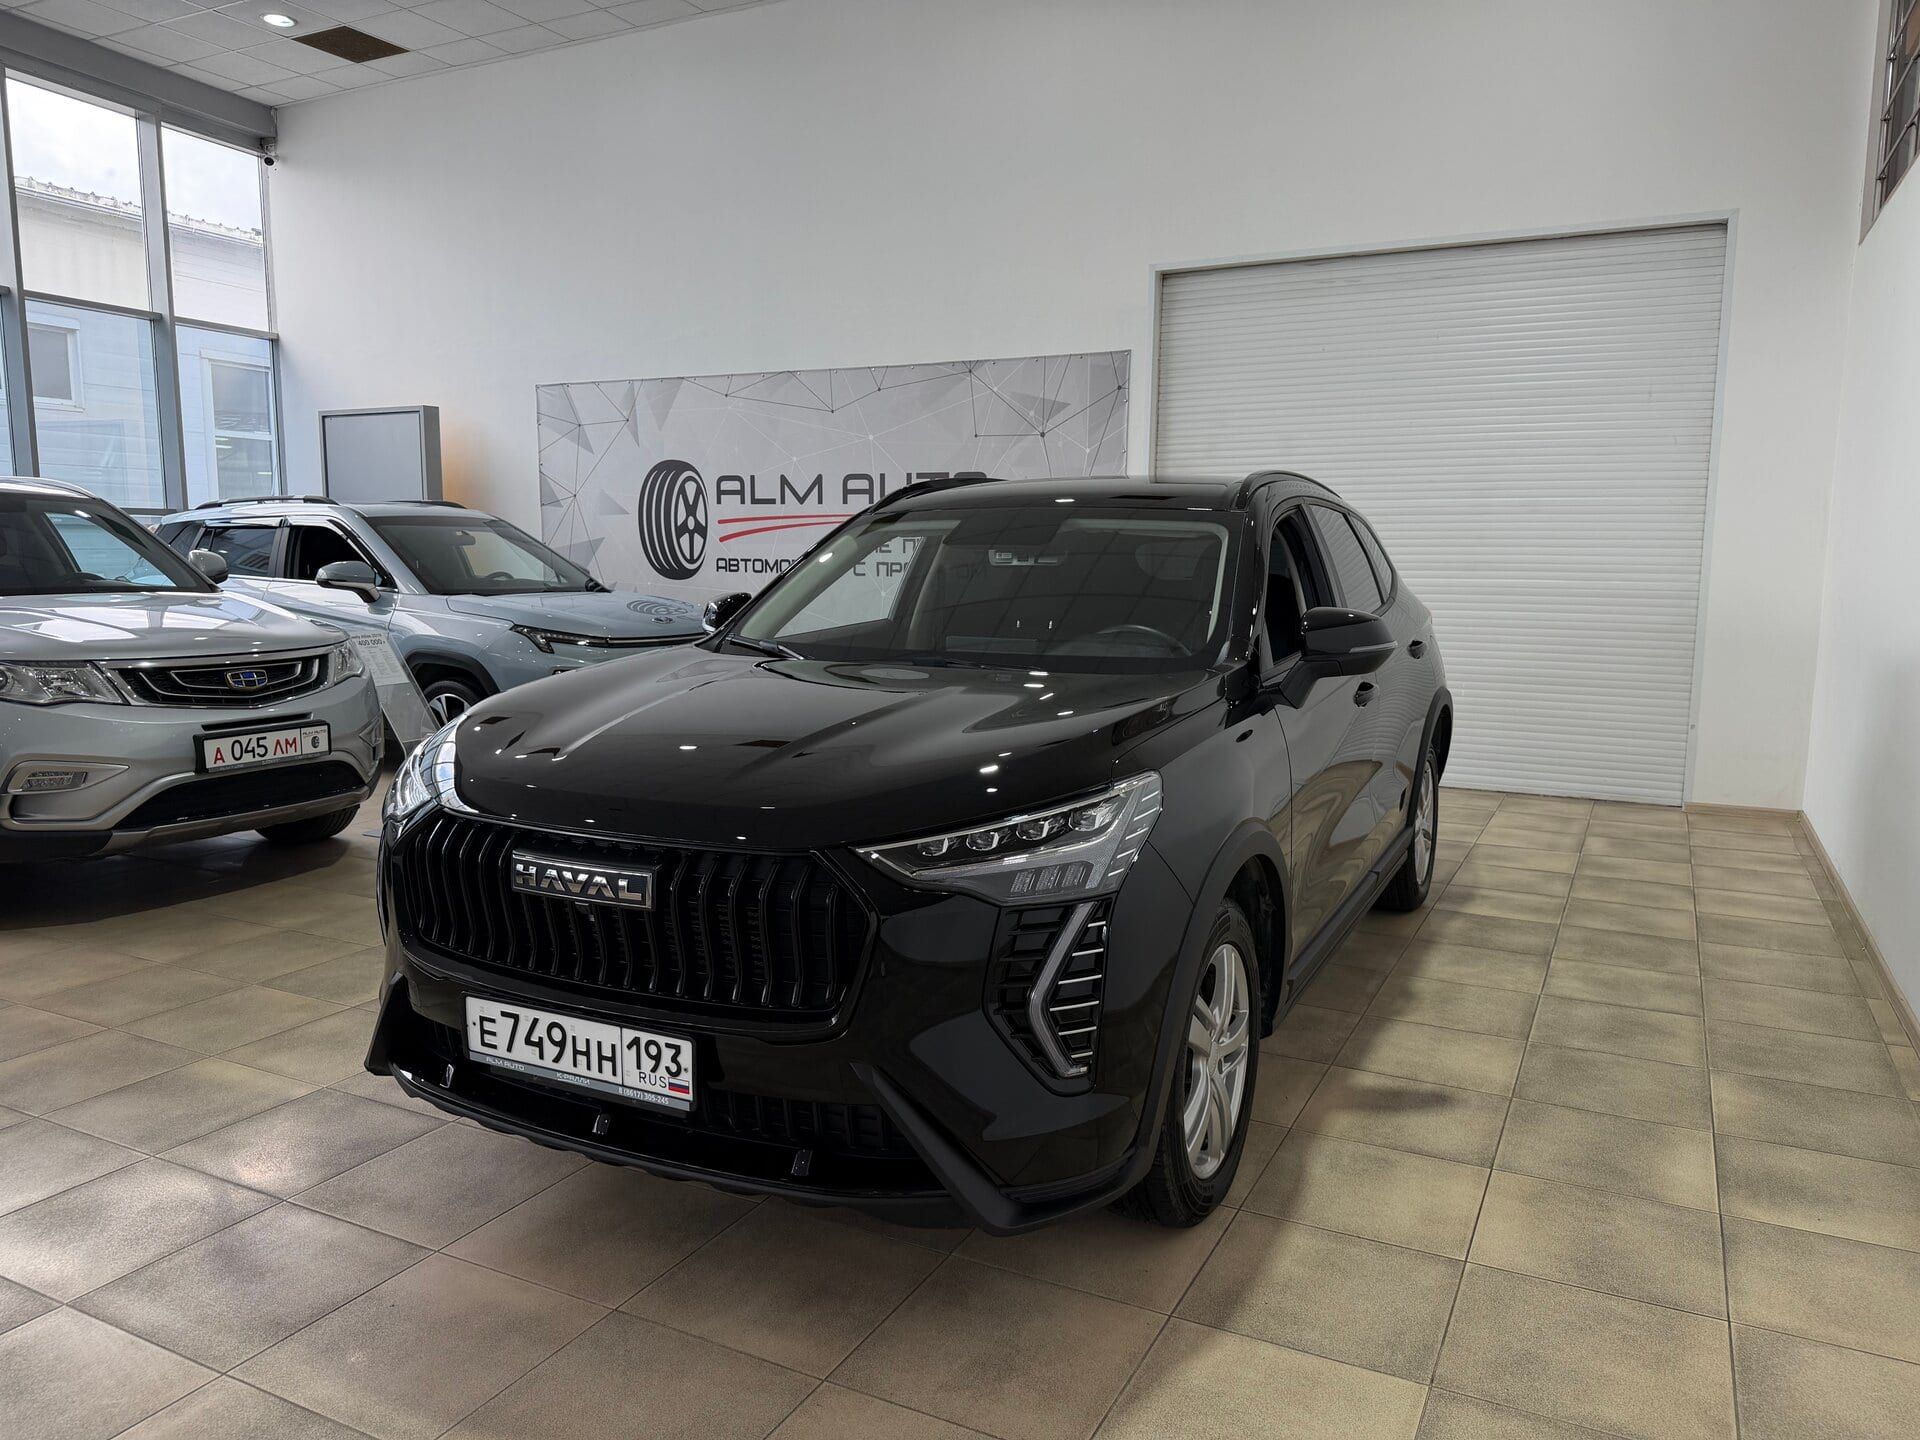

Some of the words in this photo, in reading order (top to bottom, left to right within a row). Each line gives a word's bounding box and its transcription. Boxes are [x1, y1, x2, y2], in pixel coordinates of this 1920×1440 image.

[716, 473, 823, 505] ALM
[842, 472, 987, 504] AU
[716, 558, 801, 573] АВТОМО
[231, 736, 269, 761] 045
[515, 863, 642, 900] HAVAL
[626, 1036, 682, 1078] 193
[639, 1071, 667, 1089] RUS
